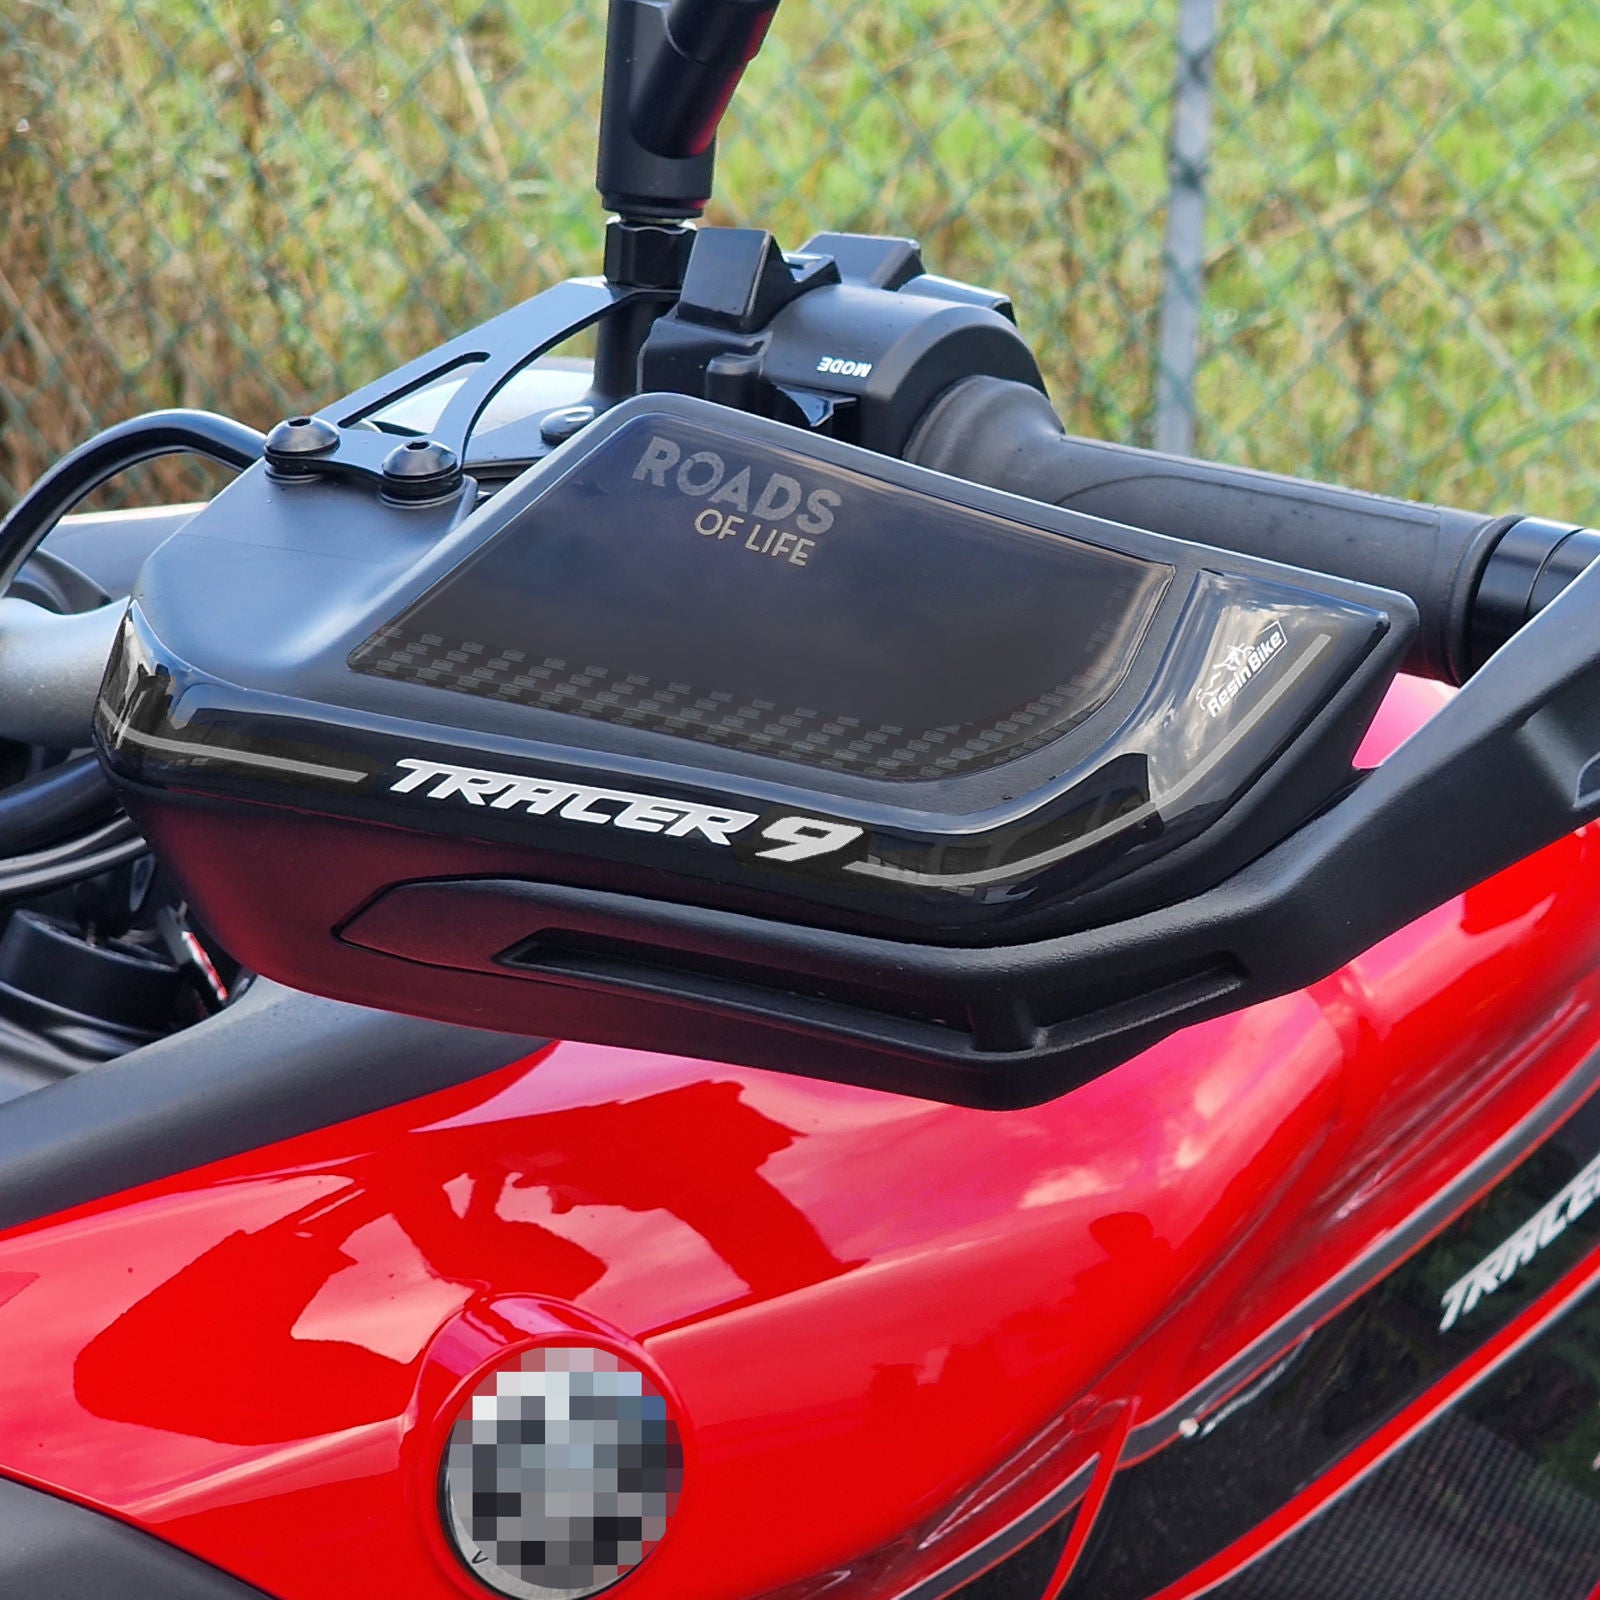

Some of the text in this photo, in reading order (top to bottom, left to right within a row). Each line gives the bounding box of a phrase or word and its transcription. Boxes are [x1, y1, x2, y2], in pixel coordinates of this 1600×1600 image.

[817, 356, 872, 378] MODE
[632, 436, 842, 535] ROADS
[694, 508, 816, 567] OF LIFE
[390, 758, 865, 862] TRACER 9
[1439, 1152, 1600, 1333] TRACE
